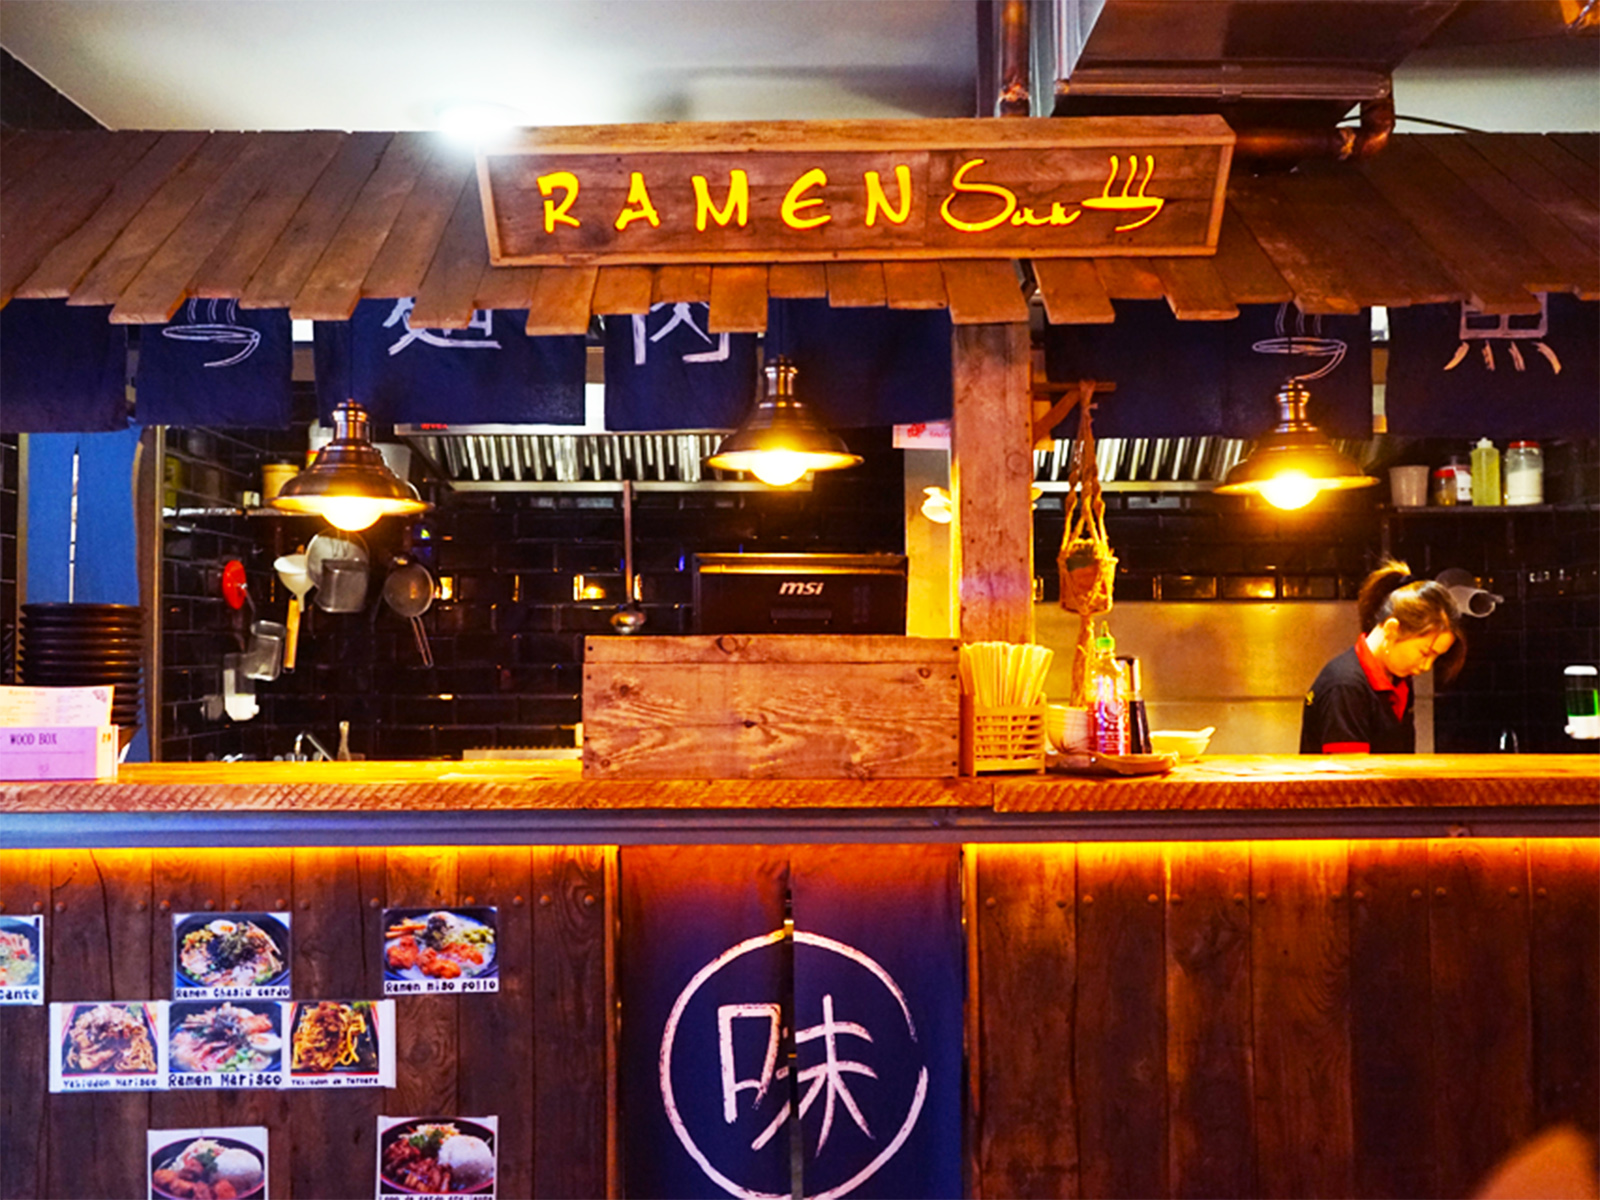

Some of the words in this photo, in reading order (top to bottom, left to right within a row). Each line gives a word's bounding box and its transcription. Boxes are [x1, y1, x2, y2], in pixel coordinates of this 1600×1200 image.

[536, 165, 912, 234] RAMEN
[778, 581, 825, 595] msi
[9, 732, 35, 745] WOOD
[38, 732, 58, 745] BOX
[175, 988, 208, 998] Ramen
[385, 981, 421, 993] Ramen
[461, 979, 497, 993] pollo
[167, 1073, 213, 1087] Ramen
[220, 1072, 282, 1087] Marisco
[717, 993, 879, 1158] 味
